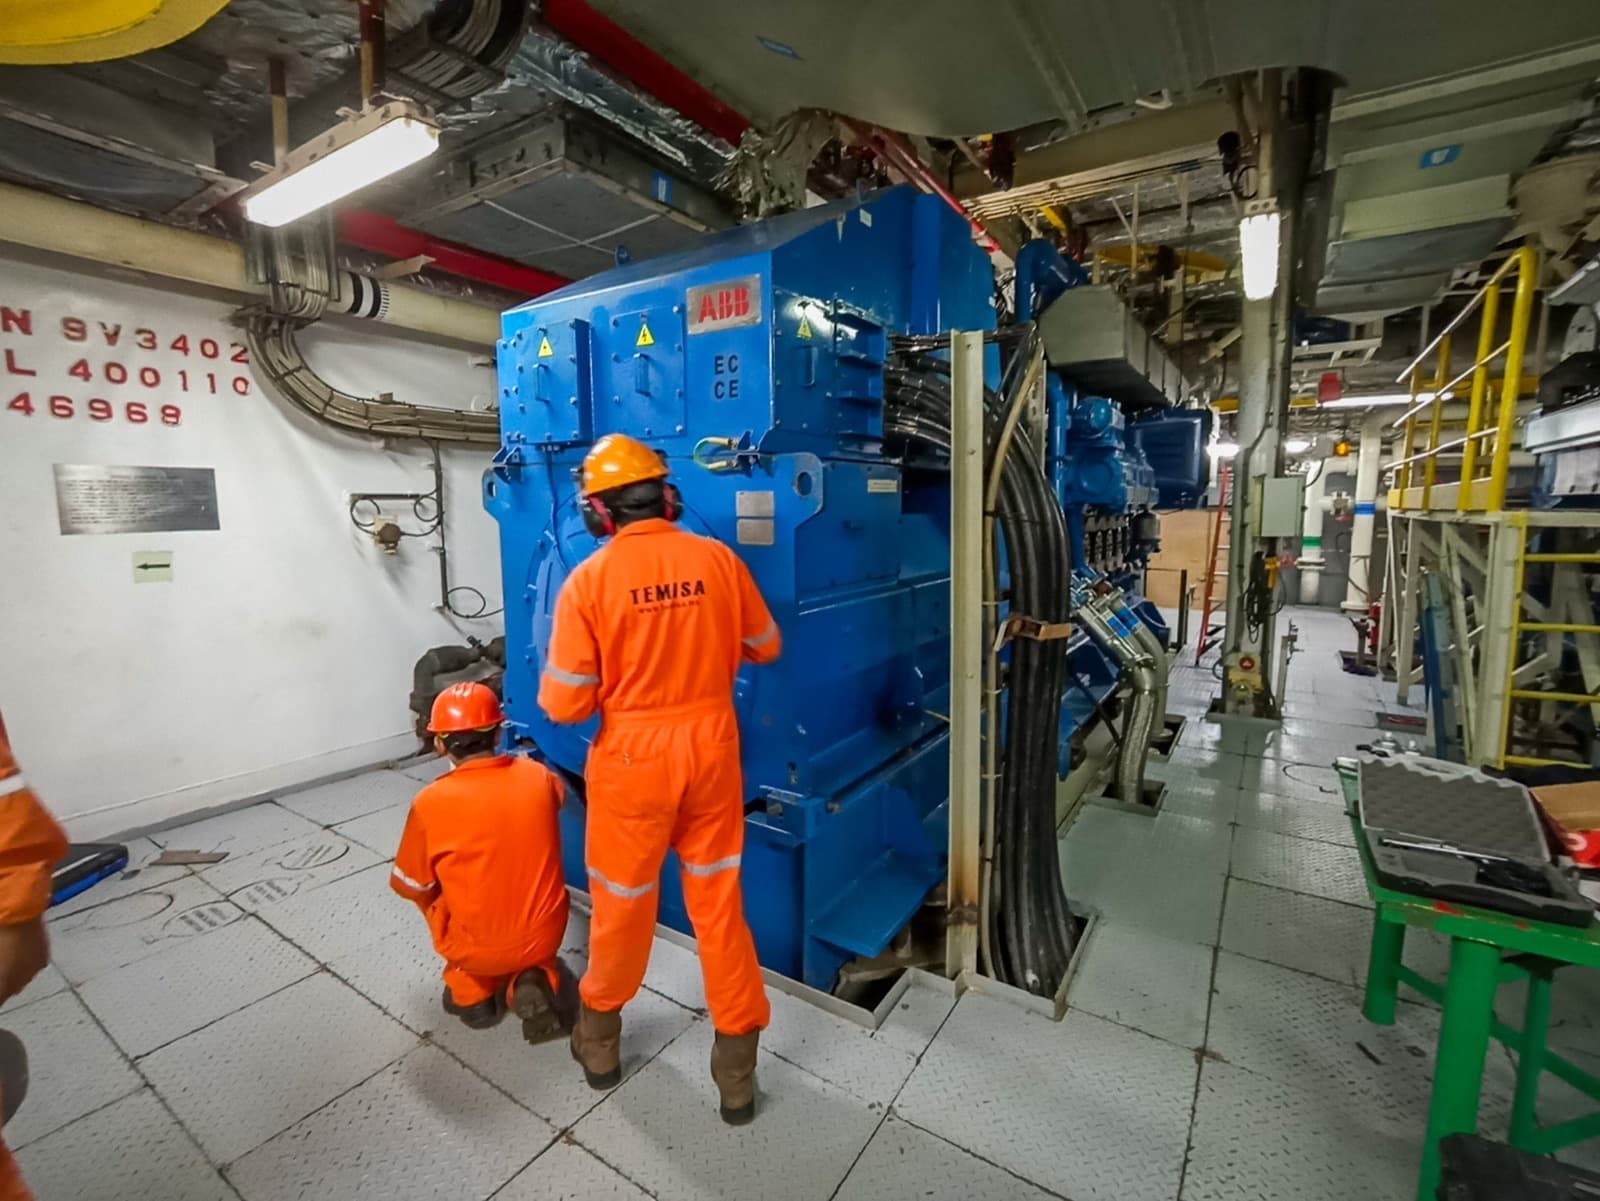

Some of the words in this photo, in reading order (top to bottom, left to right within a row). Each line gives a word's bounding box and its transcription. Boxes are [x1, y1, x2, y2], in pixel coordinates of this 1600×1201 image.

[698, 287, 750, 323] ABB
[4, 349, 37, 377] L
[629, 579, 706, 605] TEMISA
